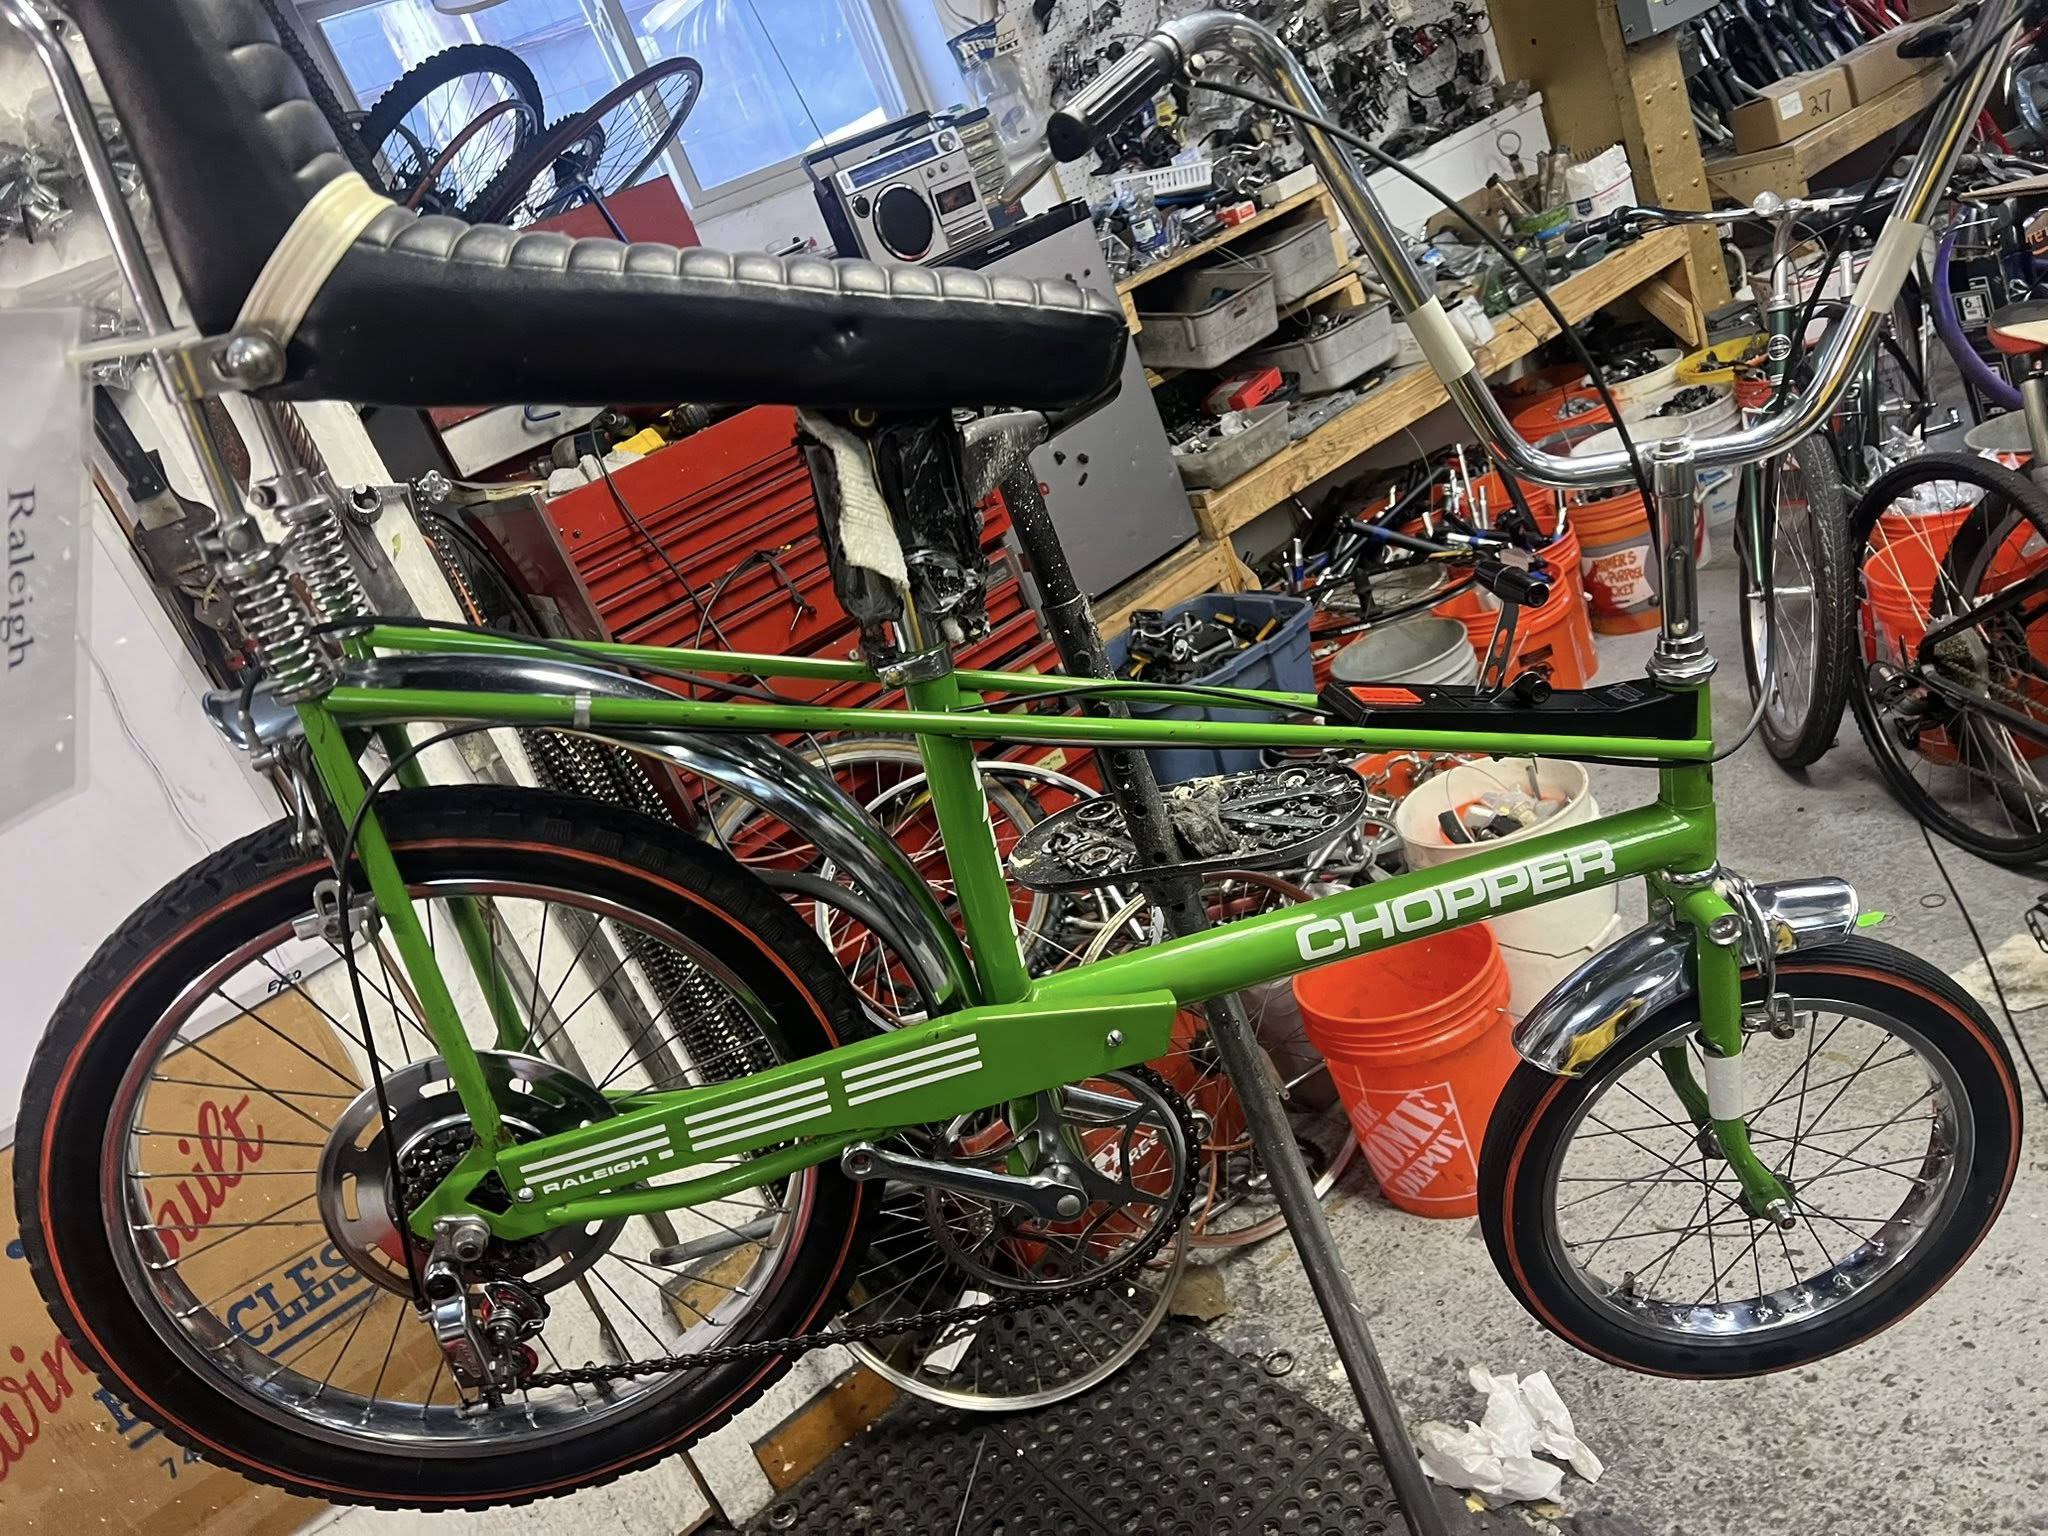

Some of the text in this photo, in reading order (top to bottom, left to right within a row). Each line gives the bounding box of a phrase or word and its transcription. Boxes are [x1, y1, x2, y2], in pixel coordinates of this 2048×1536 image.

[997, 39, 1019, 53] NXT
[1808, 88, 1832, 117] 27
[0, 485, 36, 670] Raleigh
[1295, 839, 1616, 961] CHOPPER
[1362, 1090, 1457, 1184] HOME
[1395, 1129, 1466, 1197] DEPOT
[542, 1155, 649, 1195] RALEIGH
